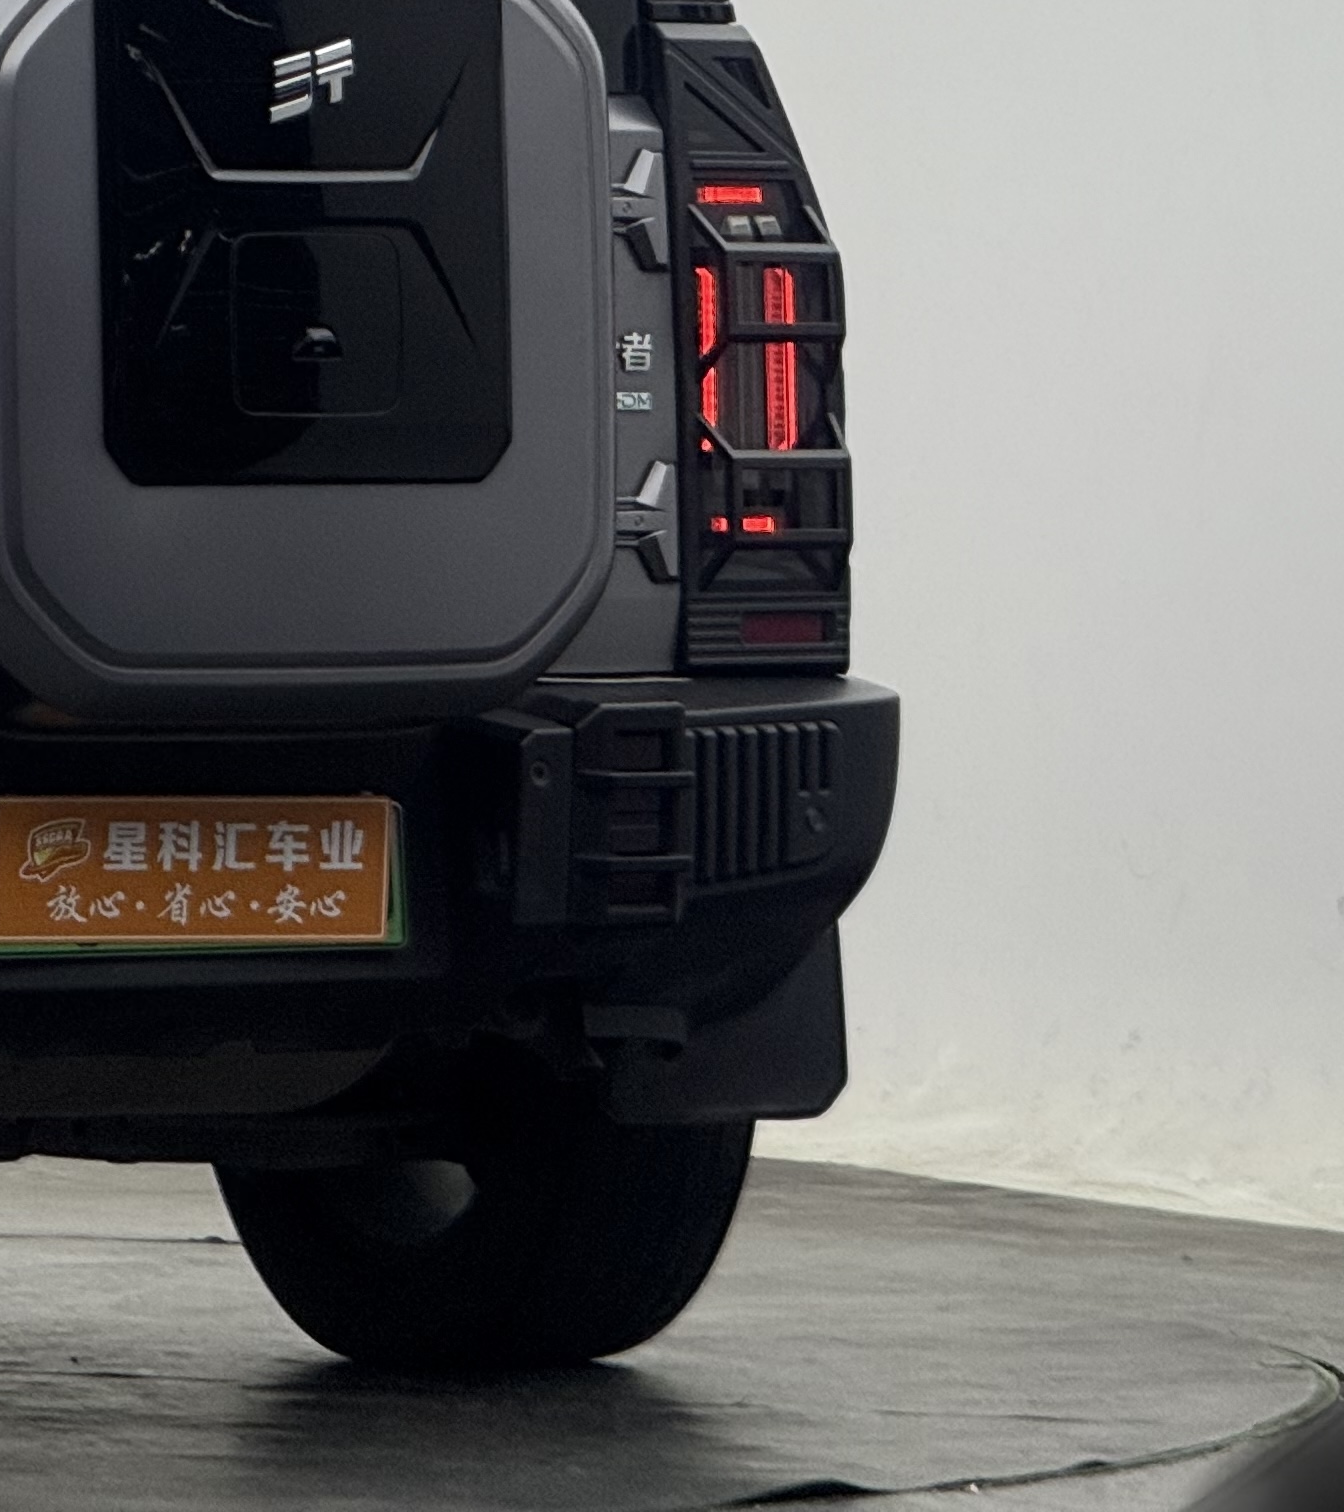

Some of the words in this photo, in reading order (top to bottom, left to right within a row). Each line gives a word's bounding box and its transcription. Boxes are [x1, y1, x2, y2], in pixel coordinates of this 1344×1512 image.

[615, 331, 653, 372] 者
[101, 819, 365, 873] 星科汇车业
